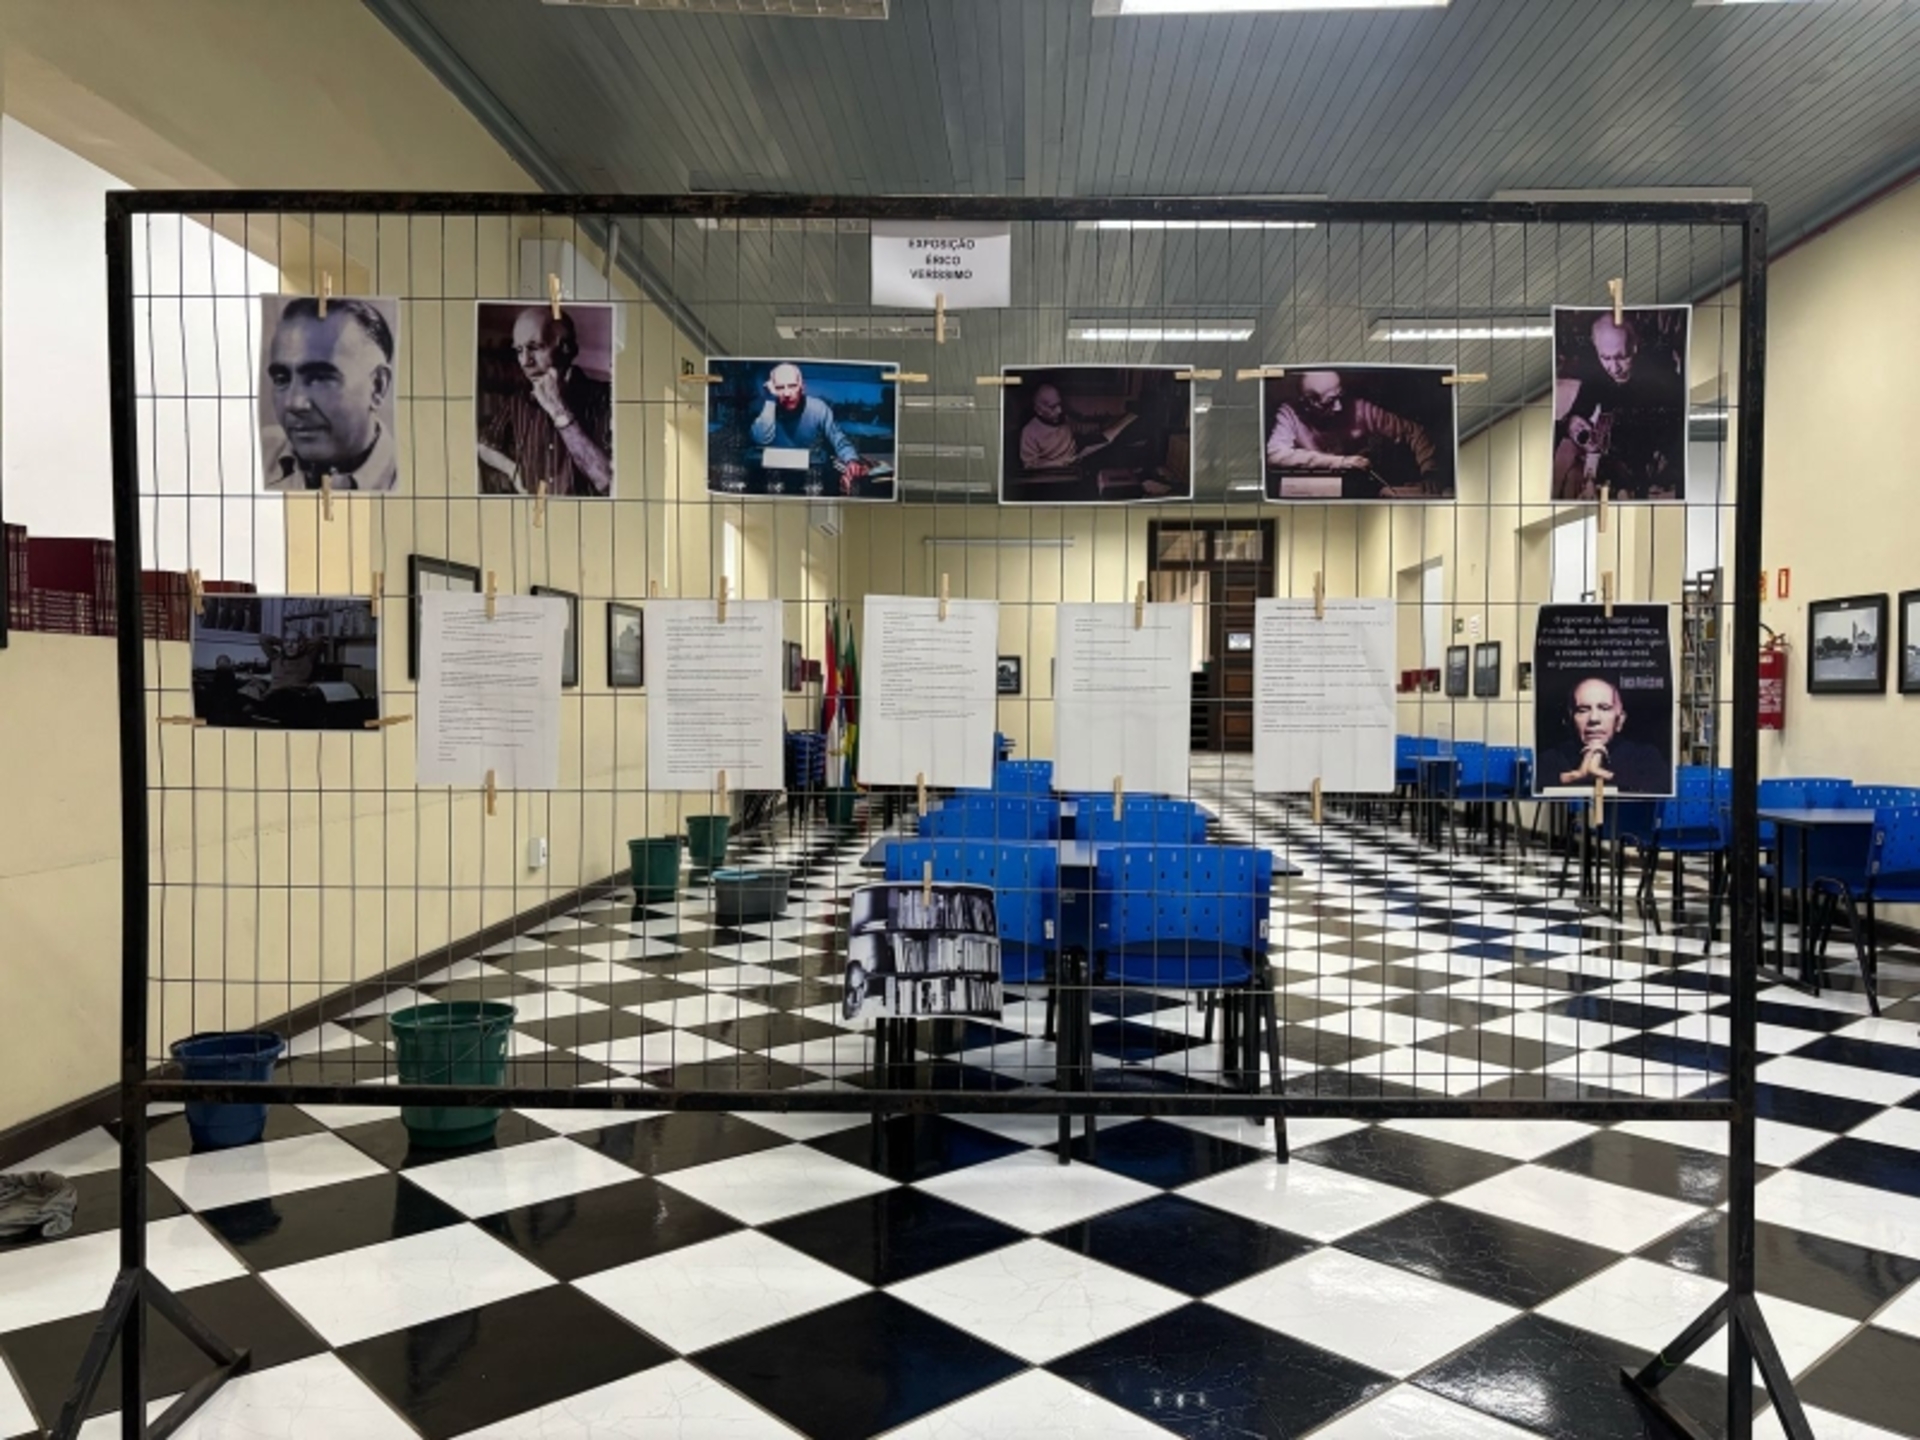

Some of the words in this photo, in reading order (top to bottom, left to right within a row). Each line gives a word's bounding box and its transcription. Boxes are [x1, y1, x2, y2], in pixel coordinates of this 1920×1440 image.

[908, 238, 975, 251] EXPOSIÇÃO
[925, 253, 961, 265] ÉRICO
[910, 267, 972, 280] VERÍSSIMO
[1590, 648, 1610, 657] vida
